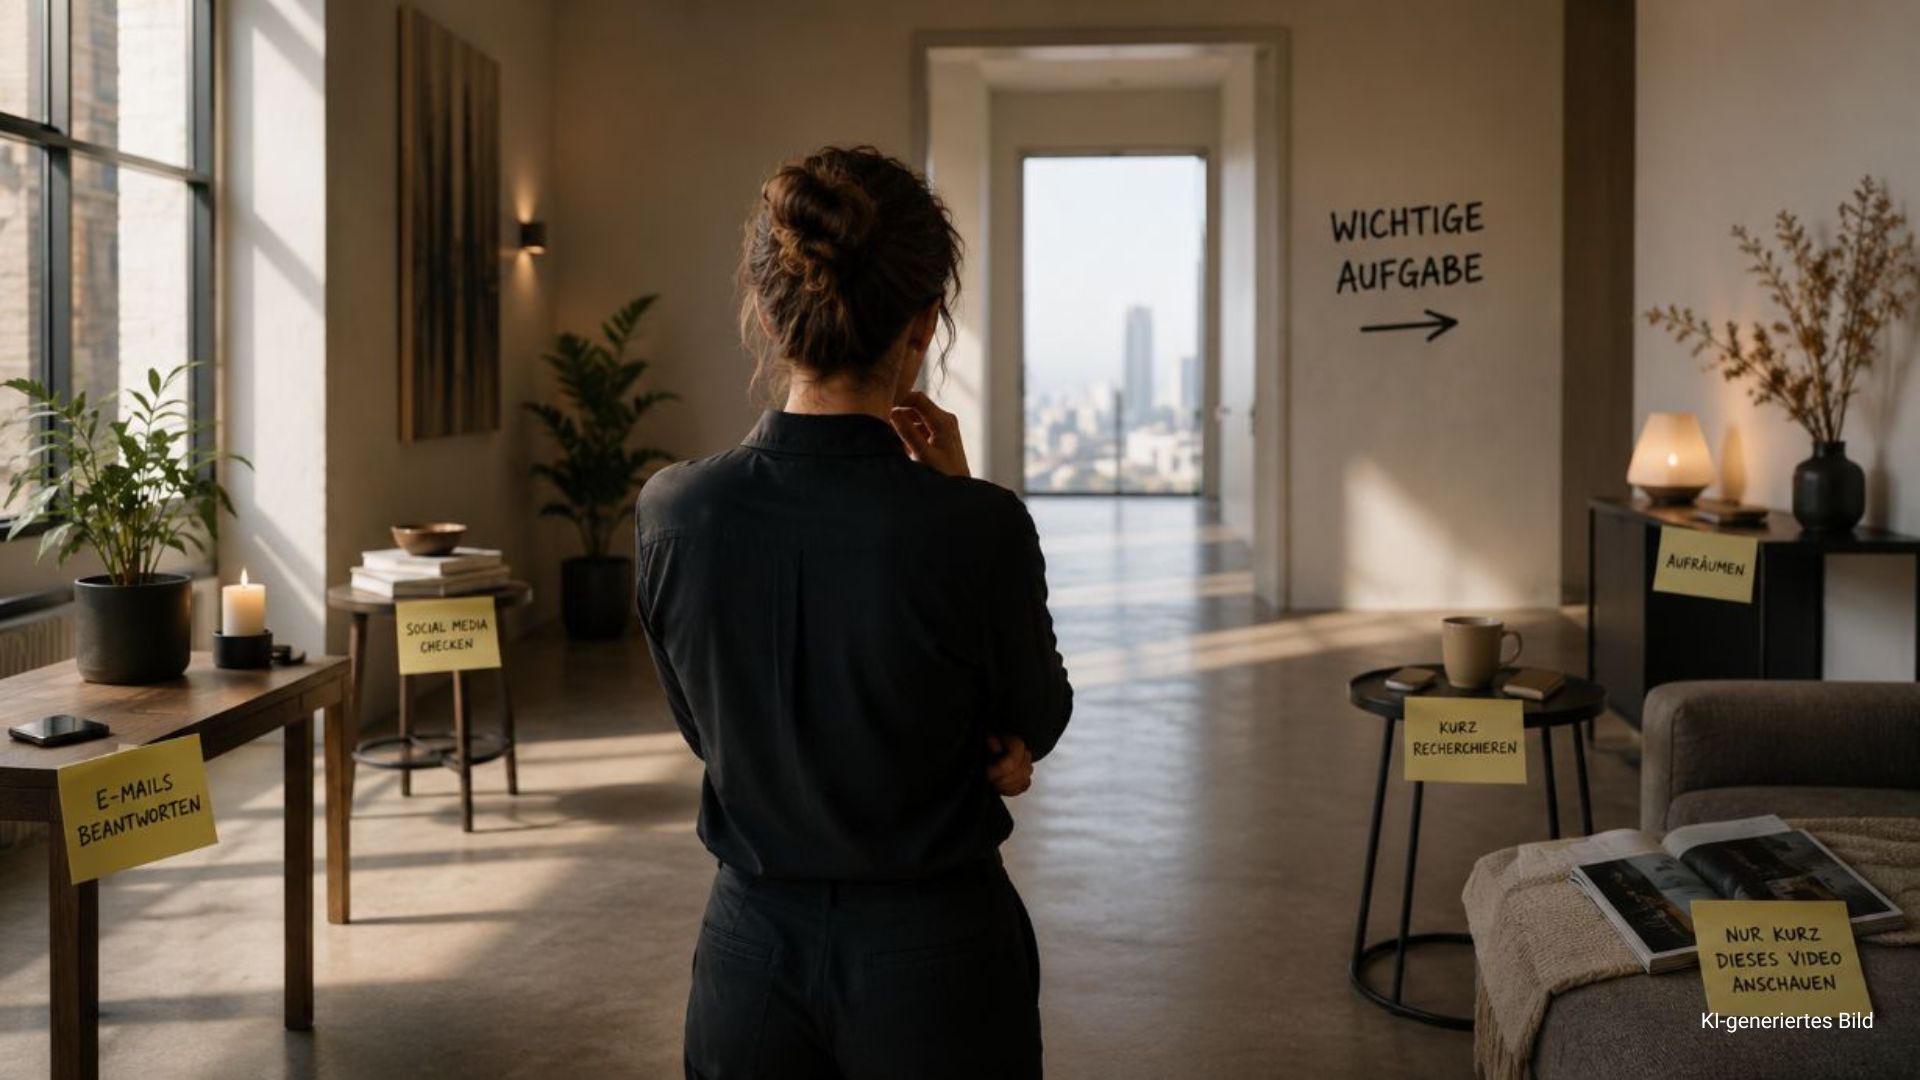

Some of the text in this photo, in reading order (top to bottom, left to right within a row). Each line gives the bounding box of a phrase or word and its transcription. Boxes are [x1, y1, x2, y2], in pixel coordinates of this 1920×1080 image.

[1330, 201, 1485, 243] WICHTIGE
[1336, 253, 1484, 294] AUFGABE
[406, 618, 488, 636] SOCIAL MEDIA
[420, 638, 474, 653] CHECKEN
[1439, 720, 1479, 734] KURZ
[1413, 741, 1518, 756] RECHERCHIEREN
[96, 773, 174, 811] E-MAILS
[77, 794, 201, 847] BEANTWORTEN
[1726, 926, 1823, 943] NUR KURZ
[1714, 951, 1843, 970] DIESES VIDEO
[1732, 974, 1837, 993] ANSCHAUEN
